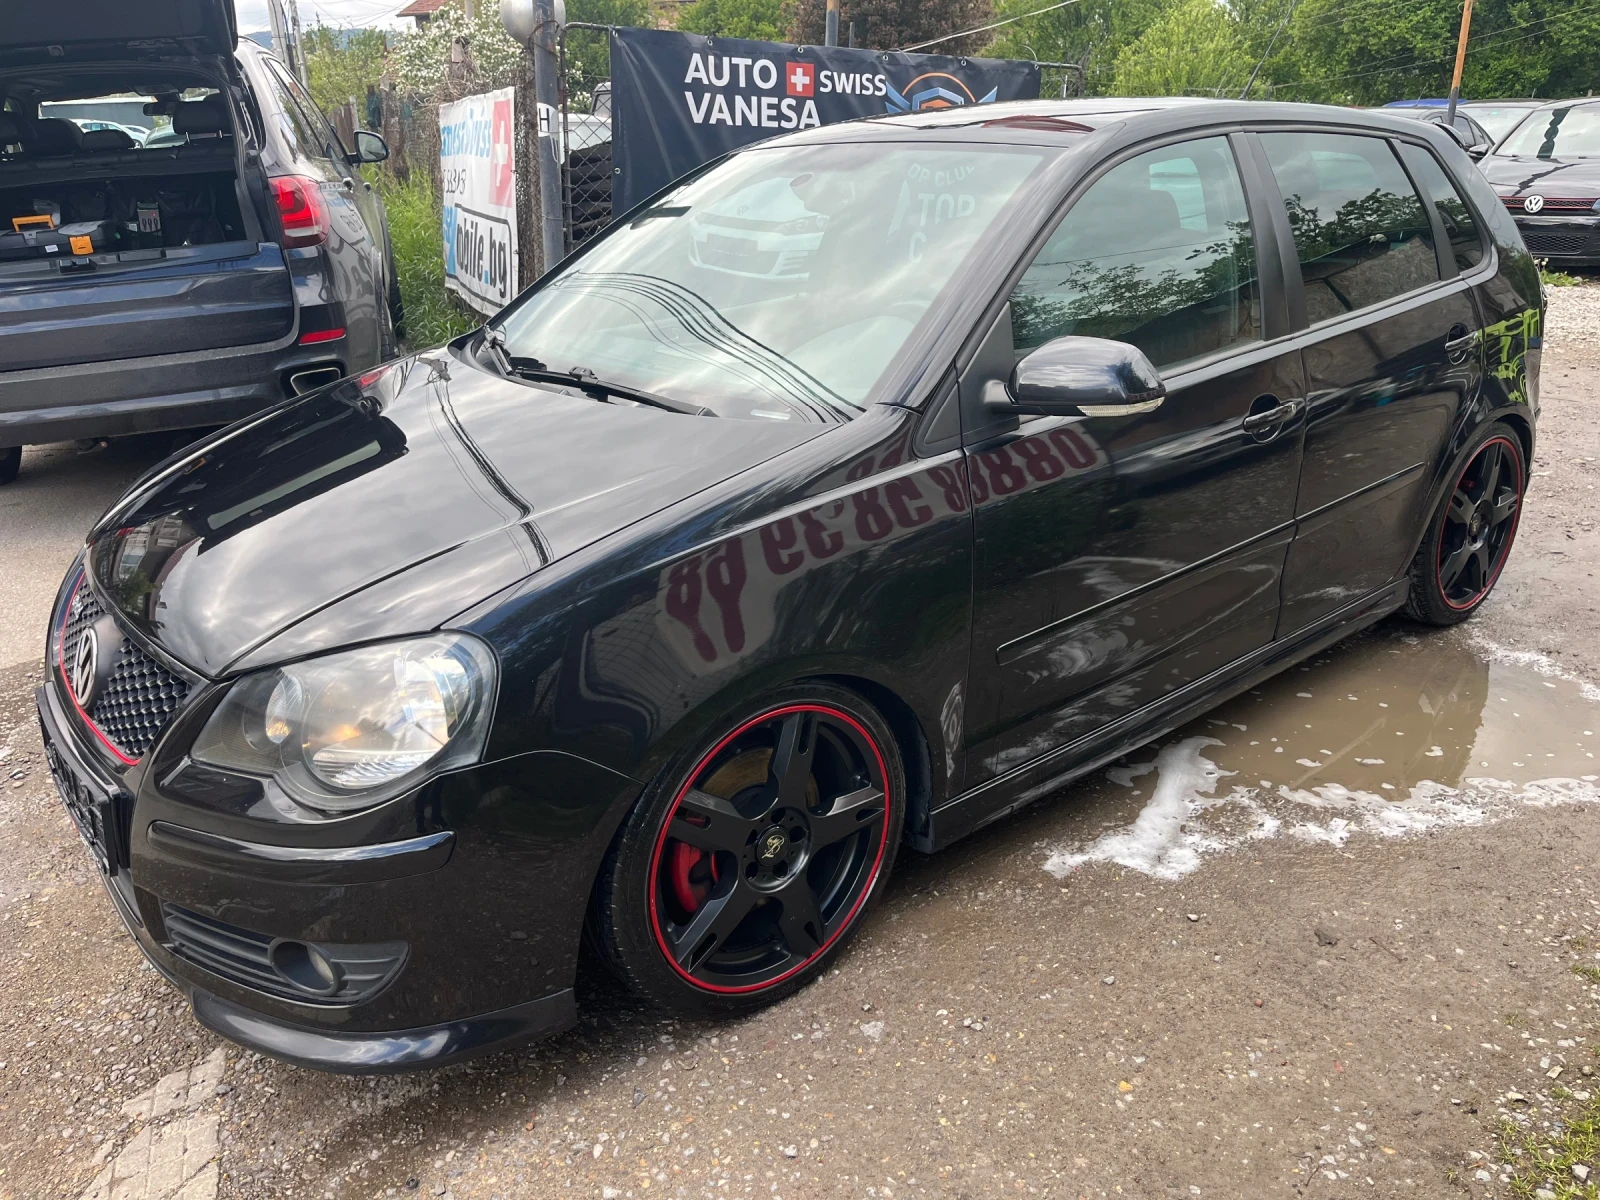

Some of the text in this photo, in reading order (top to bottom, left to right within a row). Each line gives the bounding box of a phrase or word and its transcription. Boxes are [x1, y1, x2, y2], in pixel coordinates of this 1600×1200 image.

[684, 52, 887, 97] AUTO SWISS
[685, 91, 821, 129] VANESA
